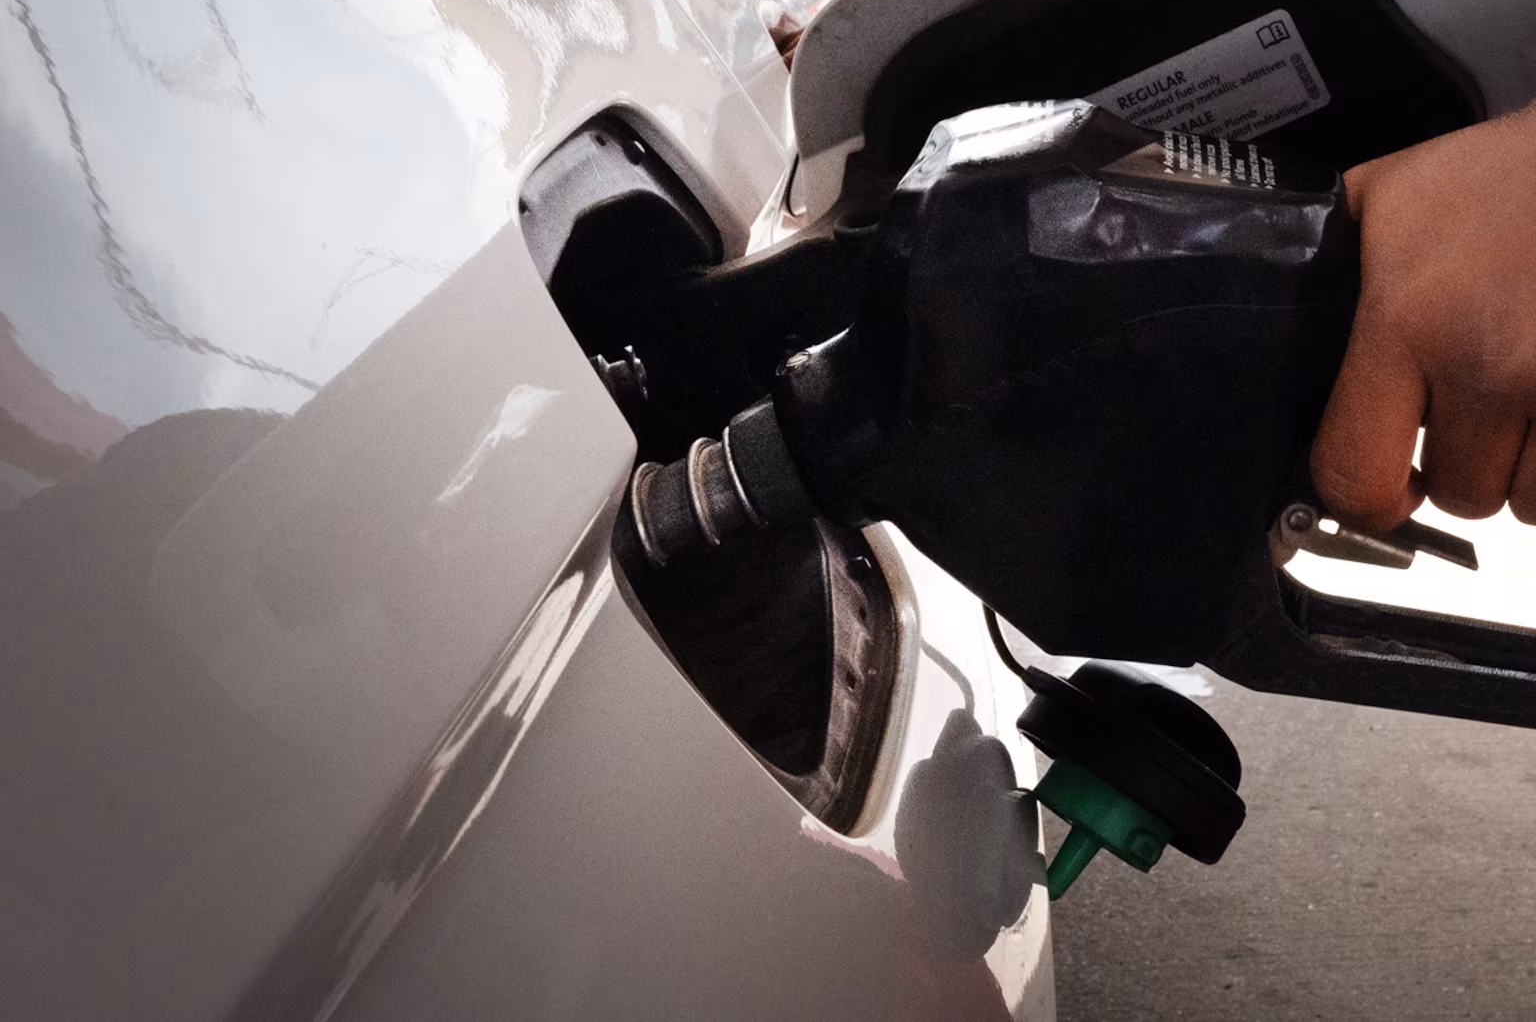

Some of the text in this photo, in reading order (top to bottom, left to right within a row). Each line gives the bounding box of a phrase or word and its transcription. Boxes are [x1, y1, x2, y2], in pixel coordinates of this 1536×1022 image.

[1116, 69, 1187, 111] REGULAR
[1124, 72, 1223, 123] unleaded fuel only
[1137, 108, 1174, 131] ithout
[1174, 100, 1196, 116] any
[1194, 78, 1239, 106] metallic
[1236, 56, 1288, 87] additives
[1223, 107, 1259, 130] Plomb
